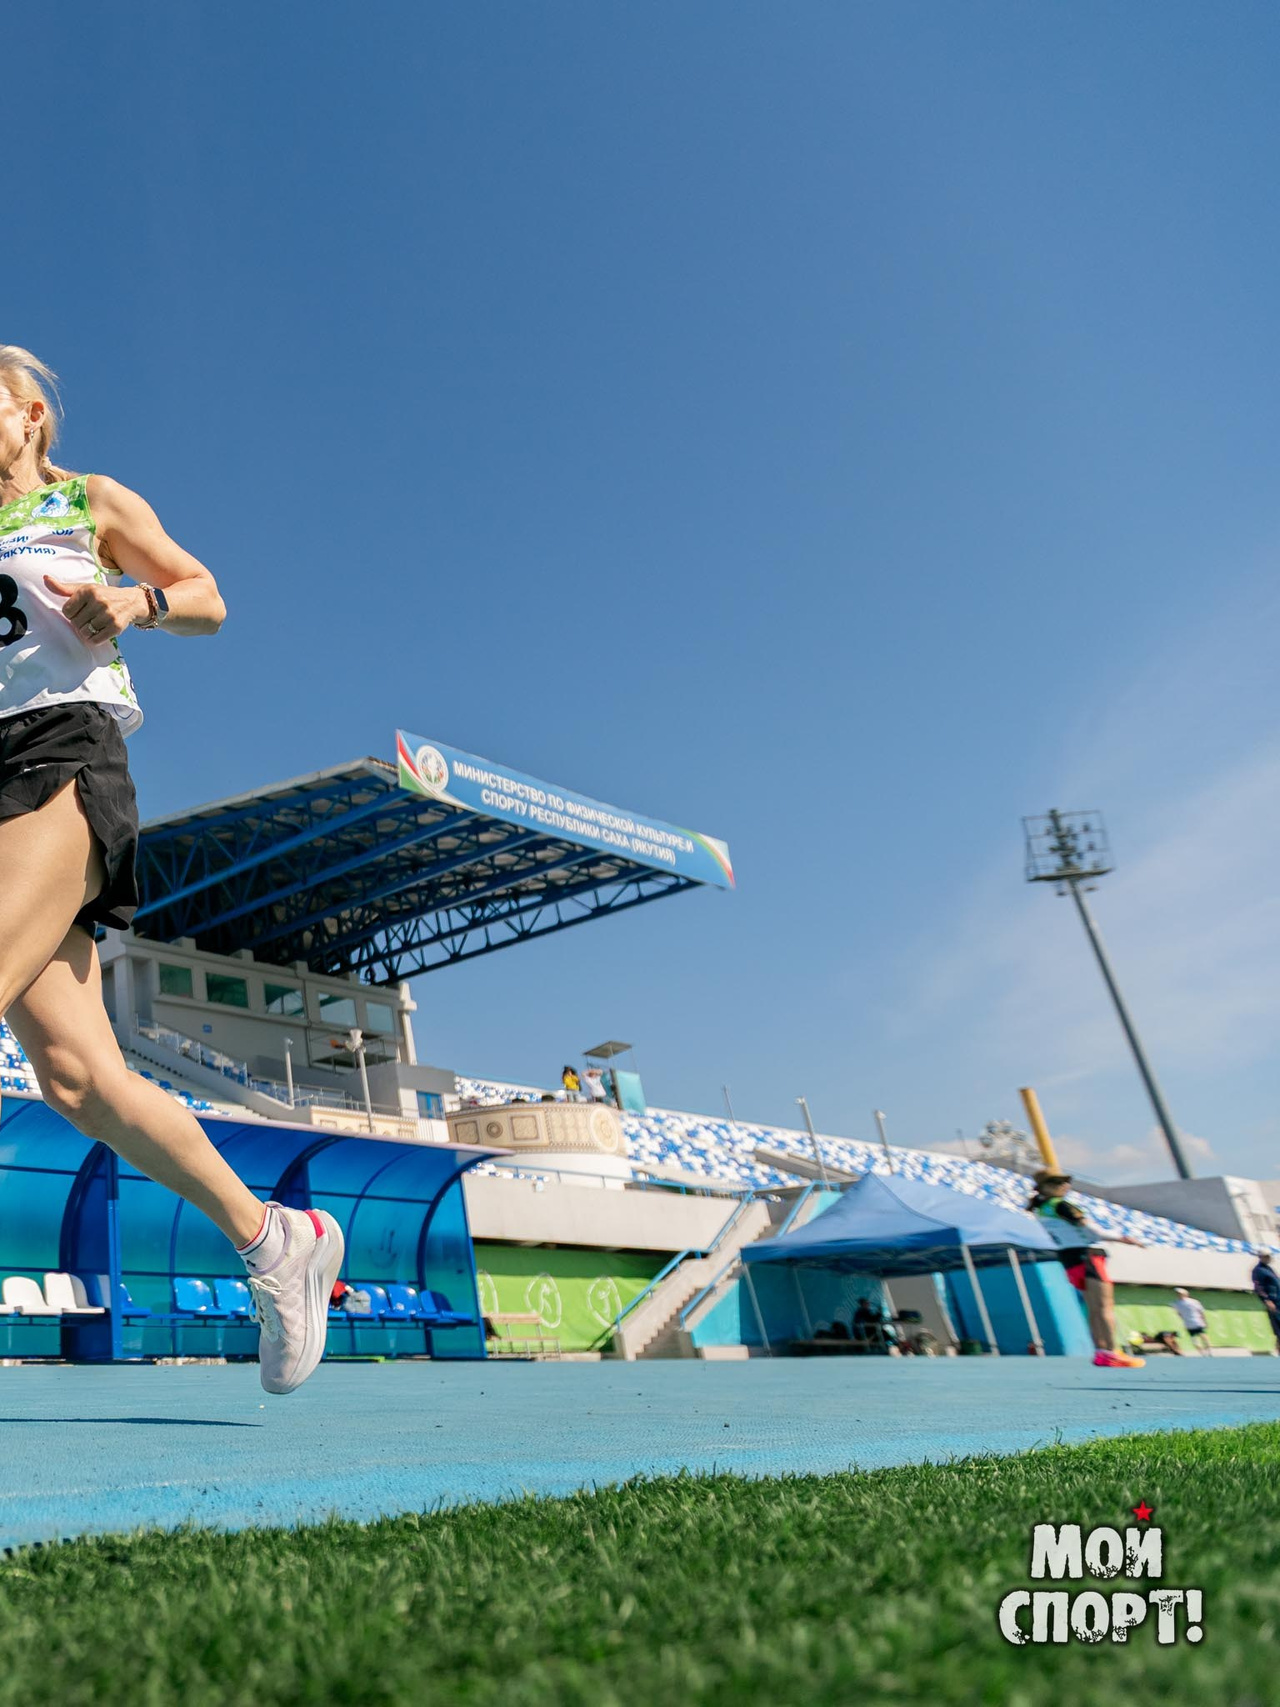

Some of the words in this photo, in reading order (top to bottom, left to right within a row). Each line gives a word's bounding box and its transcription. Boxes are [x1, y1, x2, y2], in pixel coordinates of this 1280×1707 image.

[453, 760, 546, 805] МИНИСТЕРСТВО
[547, 793, 564, 811] ПО
[565, 801, 636, 834] ФИЗИЧЕСКОЙ
[637, 823, 684, 852] КУЛЬТУРЕ
[685, 839, 694, 853] И
[481, 788, 527, 816] СПОРТУ
[530, 804, 601, 839] РЕСПУБЛИКИ
[602, 827, 631, 848] САХА
[632, 837, 676, 866] (ЯКУТИЯ)
